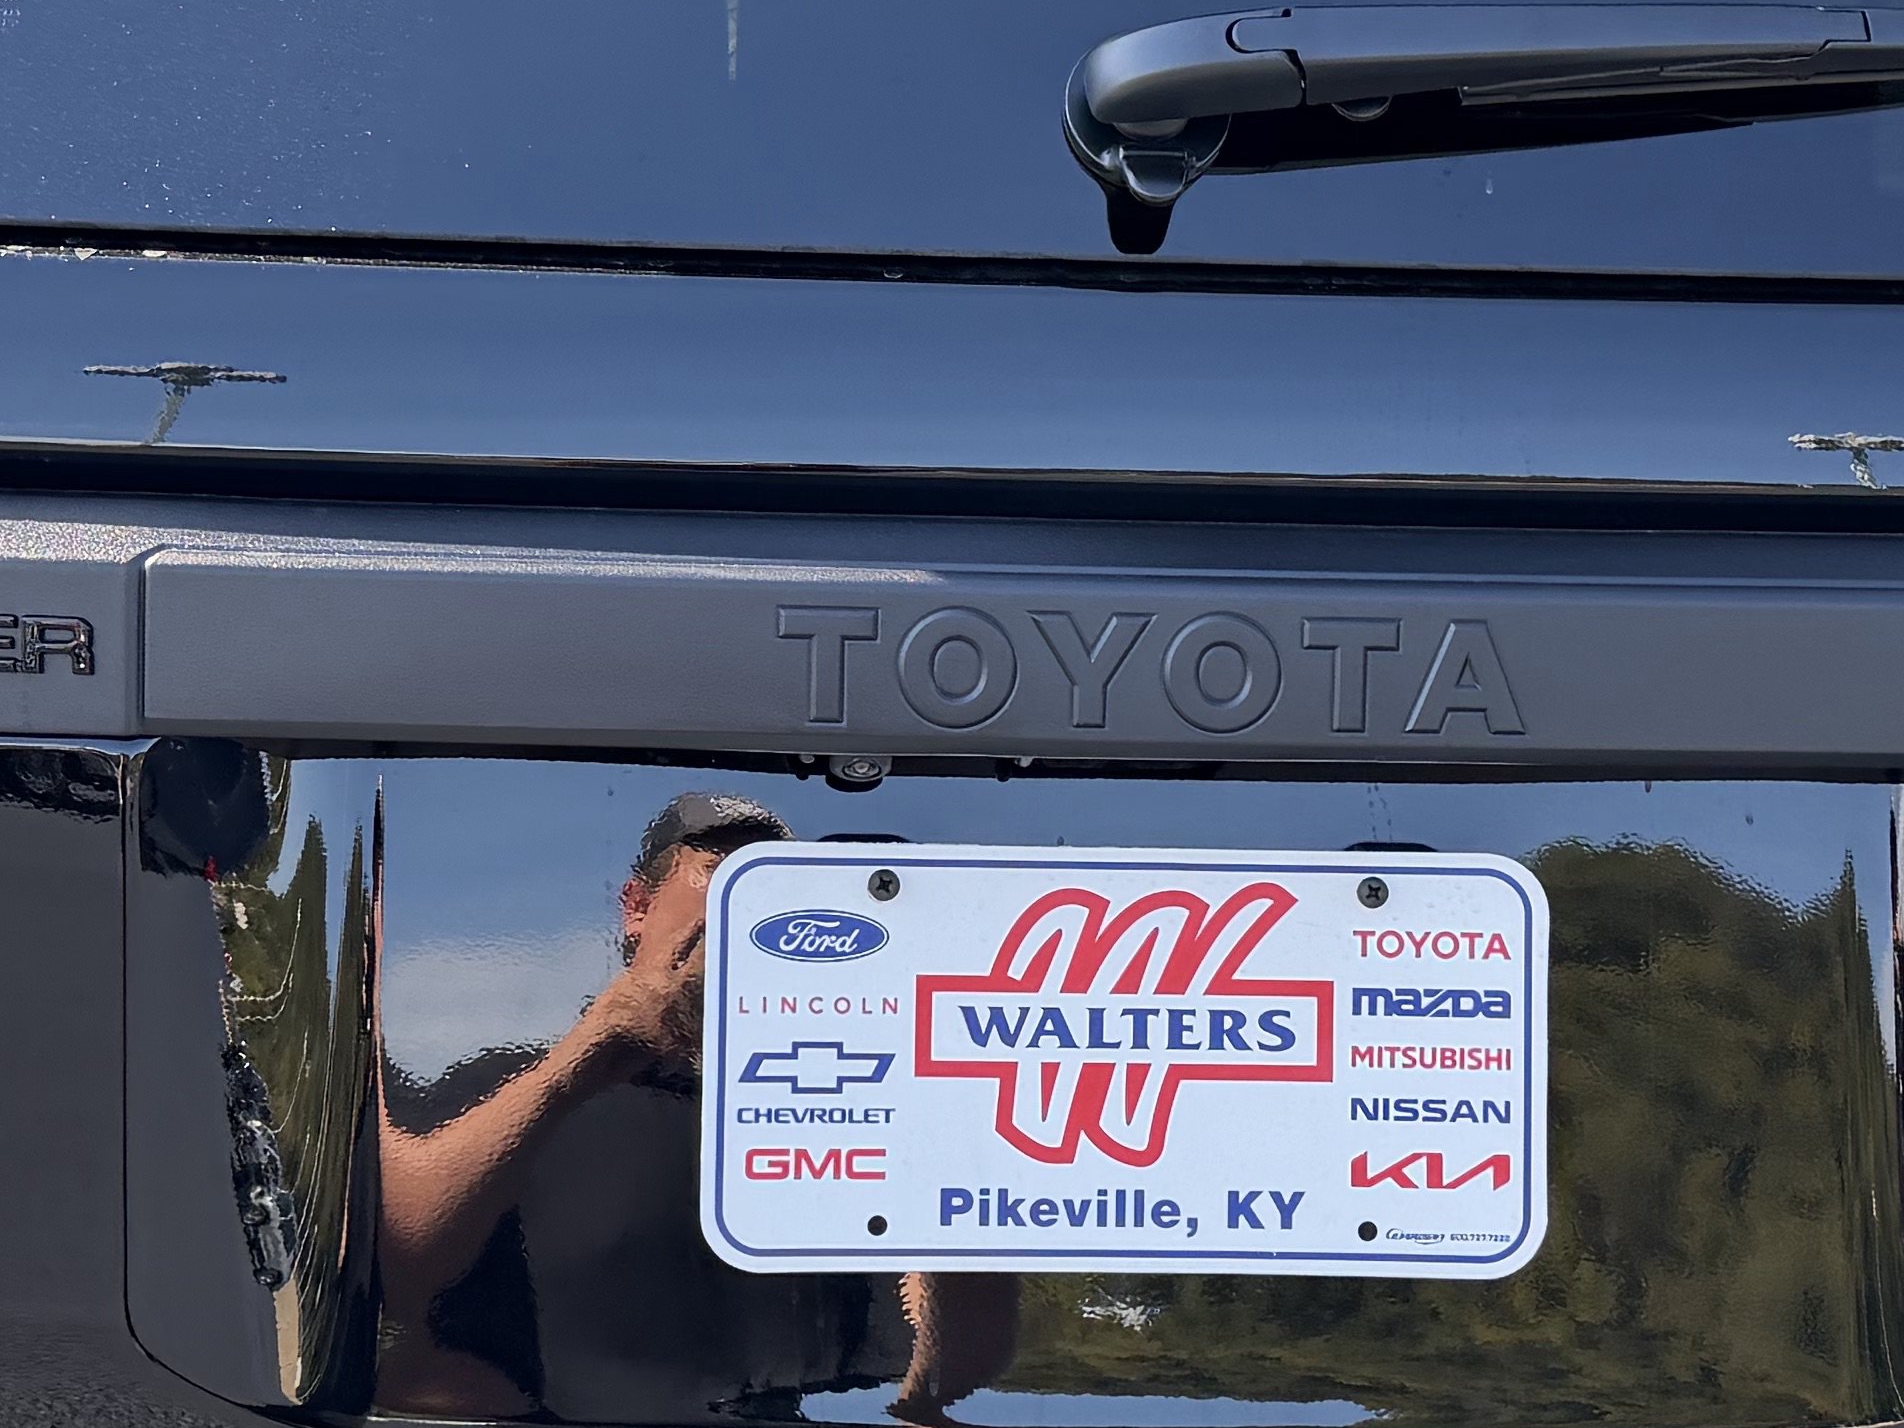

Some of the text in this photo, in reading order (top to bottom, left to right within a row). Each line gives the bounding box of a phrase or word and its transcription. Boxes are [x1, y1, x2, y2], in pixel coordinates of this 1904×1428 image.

[776, 604, 1527, 736] TOYOTA
[778, 916, 858, 956] Ford
[1352, 930, 1511, 961] TOYOTA
[738, 996, 898, 1015] LINCOLN
[958, 1005, 1297, 1053] WALTERS
[1350, 1046, 1512, 1071] MITSUBISHI
[737, 1107, 896, 1125] CHEVROLET
[1350, 1097, 1512, 1124] NISSAN
[744, 1148, 887, 1181] GMC
[939, 1189, 1306, 1237] Pikeville, KY
